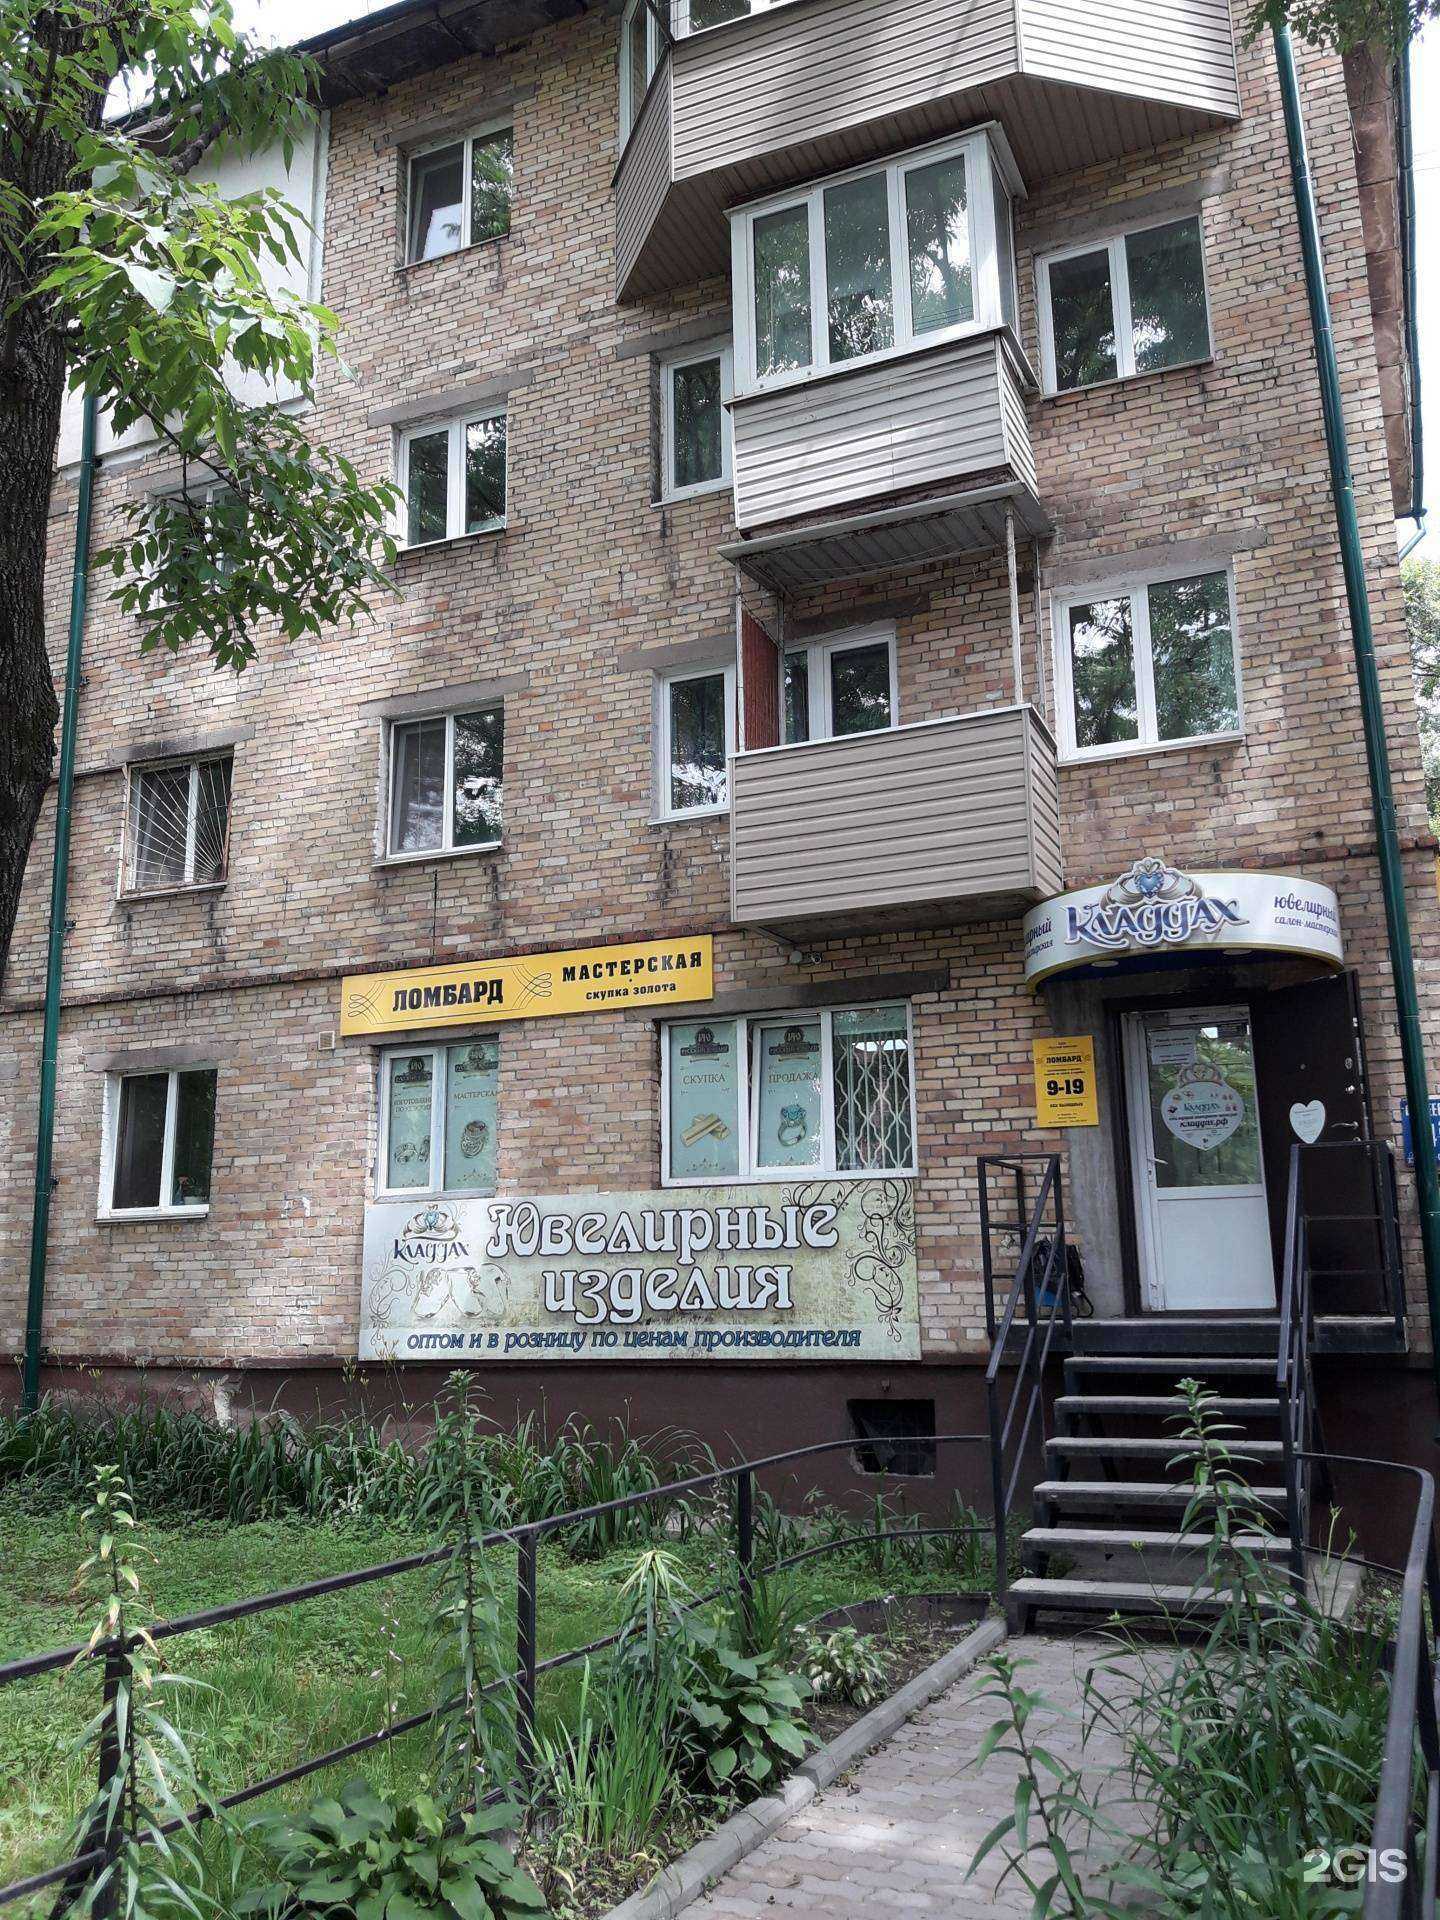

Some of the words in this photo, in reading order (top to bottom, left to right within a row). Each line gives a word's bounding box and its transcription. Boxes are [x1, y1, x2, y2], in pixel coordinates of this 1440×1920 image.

[562, 950, 703, 982] МАСТЕРСКАЯ
[392, 978, 504, 1012] ЛОМБАРД
[585, 987, 630, 1001] скупка
[632, 981, 677, 997] золота
[682, 1073, 726, 1085] СКУПКА
[768, 1071, 819, 1083] ПРОДАЖА
[1046, 1078, 1085, 1096] 9-19
[485, 1200, 839, 1266] Ювелирные
[541, 1265, 795, 1326] изделия
[406, 1332, 465, 1349] оптом
[468, 1332, 483, 1349] и
[486, 1331, 500, 1348] в
[504, 1331, 588, 1353] розницу
[591, 1330, 619, 1348] по
[623, 1329, 689, 1350] ценам
[693, 1328, 862, 1352] производителя
